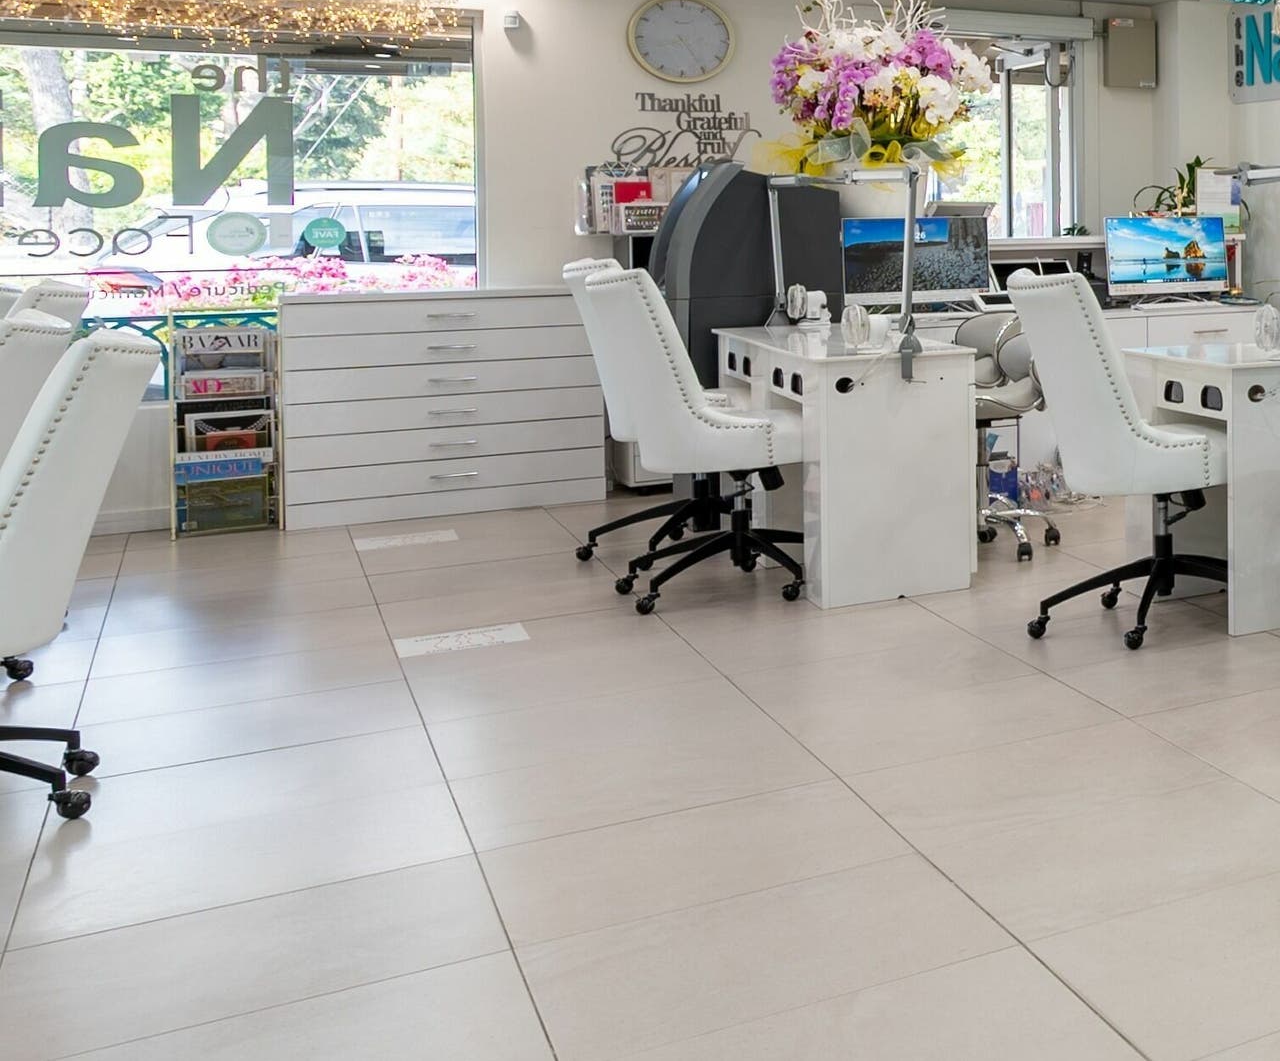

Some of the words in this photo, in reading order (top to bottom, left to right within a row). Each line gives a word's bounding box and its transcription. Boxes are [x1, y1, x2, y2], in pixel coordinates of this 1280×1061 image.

[635, 92, 721, 112] Thankful
[676, 111, 750, 131] Grateful
[700, 130, 722, 140] and
[696, 137, 738, 155] truly
